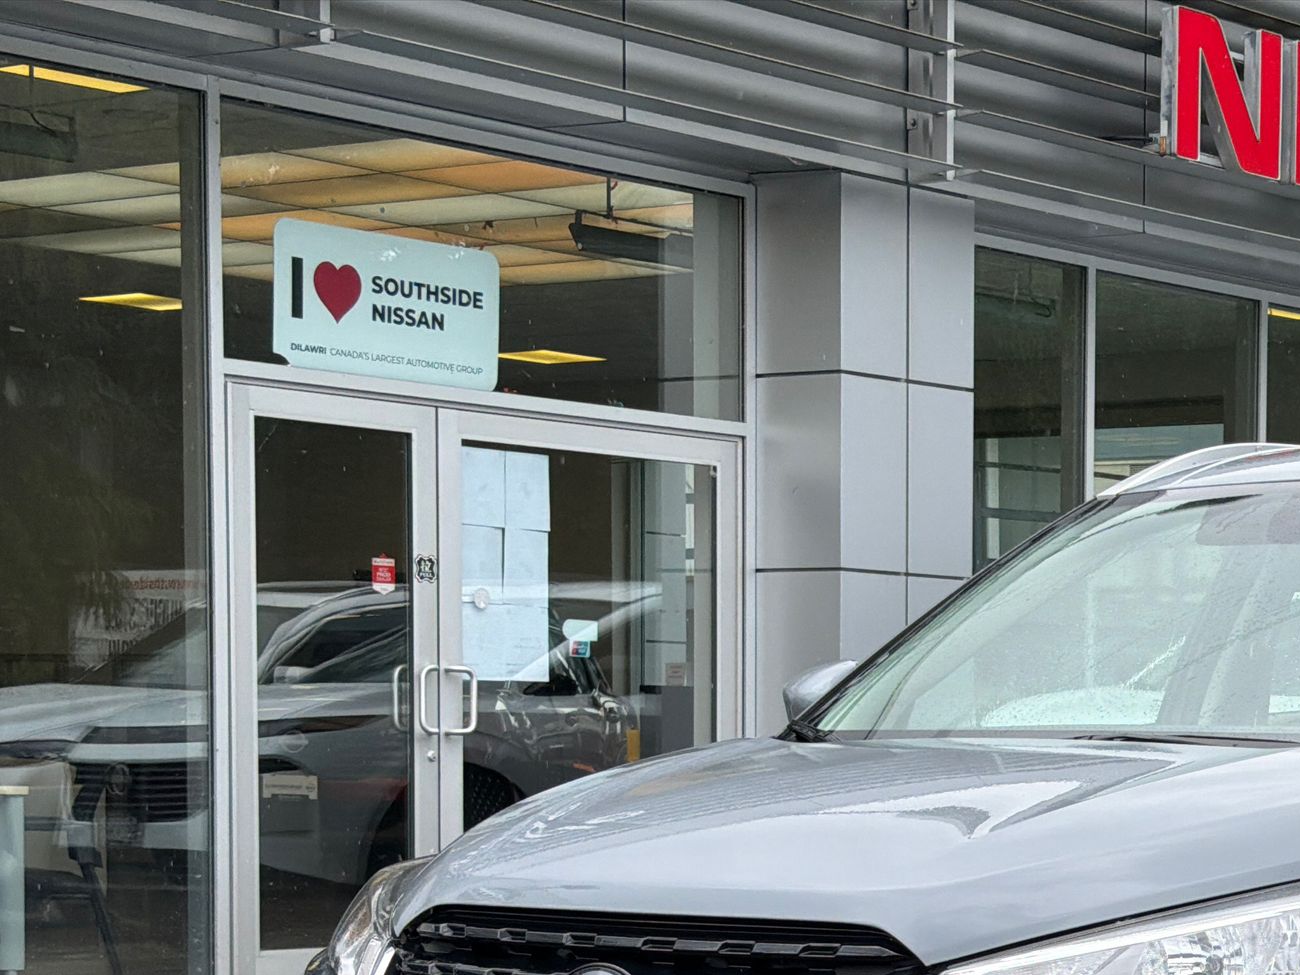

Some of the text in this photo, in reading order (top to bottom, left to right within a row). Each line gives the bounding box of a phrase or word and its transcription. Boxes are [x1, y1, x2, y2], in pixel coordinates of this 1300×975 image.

[291, 256, 304, 320] I
[371, 275, 484, 310] SOUTHSIDE
[371, 303, 446, 332] NISSAN
[290, 342, 484, 376] DILAWRI CANADA'S LARGEST AUTOMOTIVE GROUP
